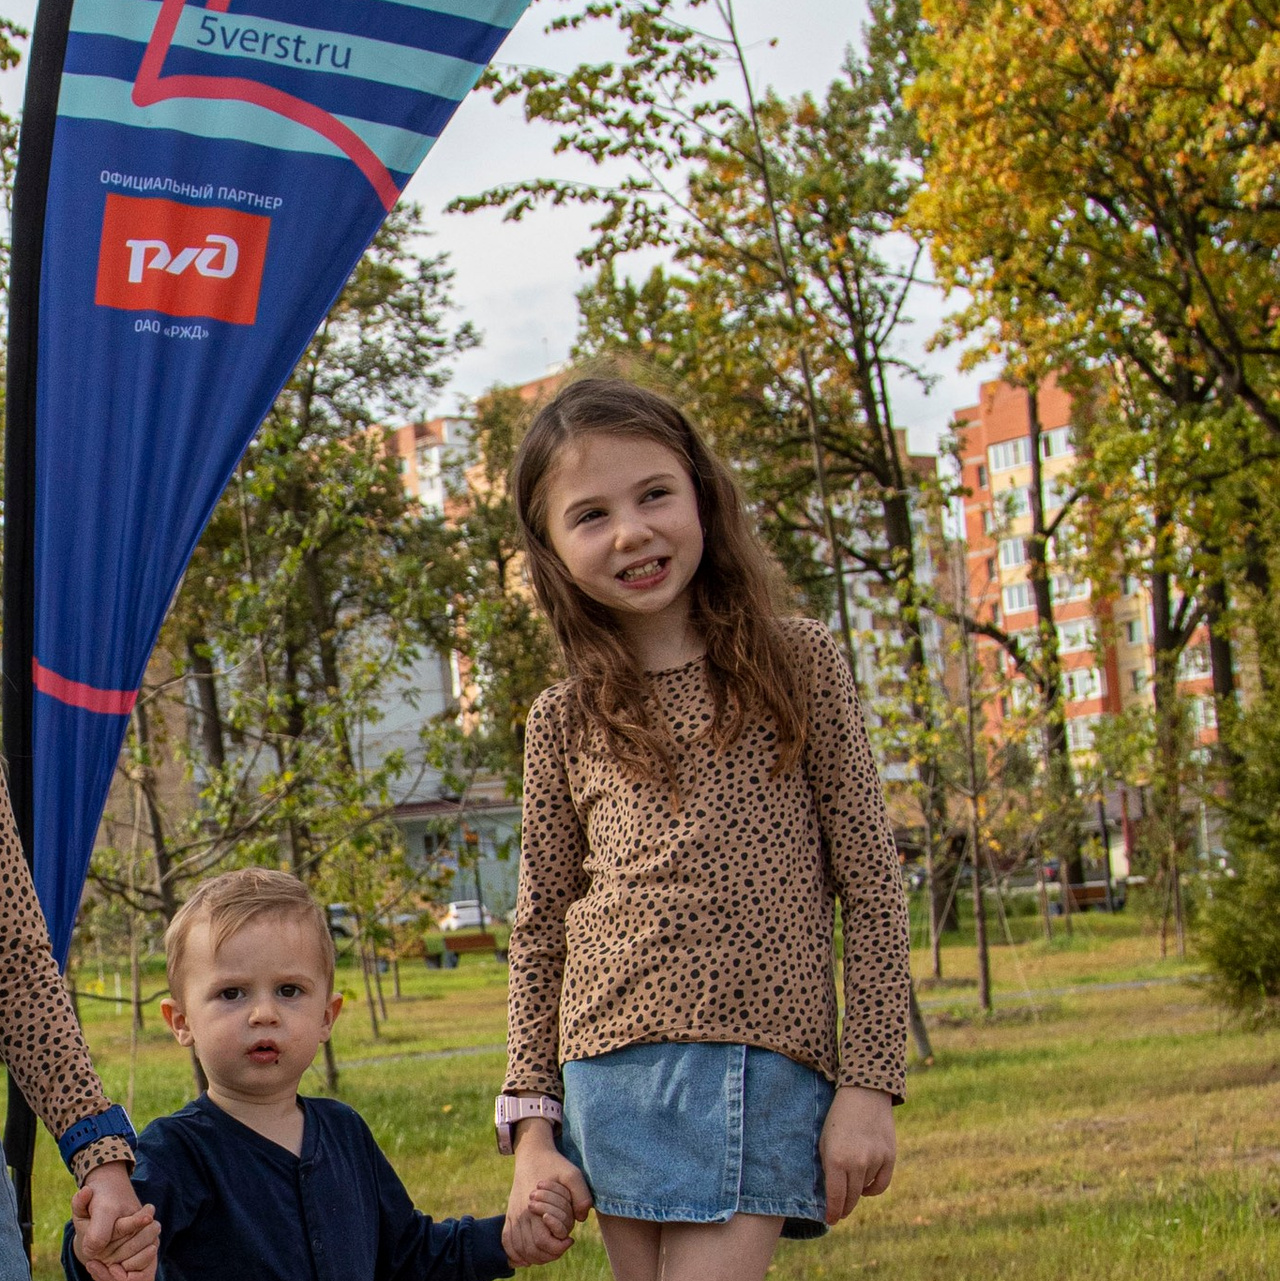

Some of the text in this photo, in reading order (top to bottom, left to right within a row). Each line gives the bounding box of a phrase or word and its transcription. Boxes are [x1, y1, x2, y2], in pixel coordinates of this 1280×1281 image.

[196, 15, 352, 70] 5verst.ru
[100, 170, 283, 210] ОФИЦИАЛЬНЫЙ ПАРТНЕР
[134, 319, 161, 333] ОАО
